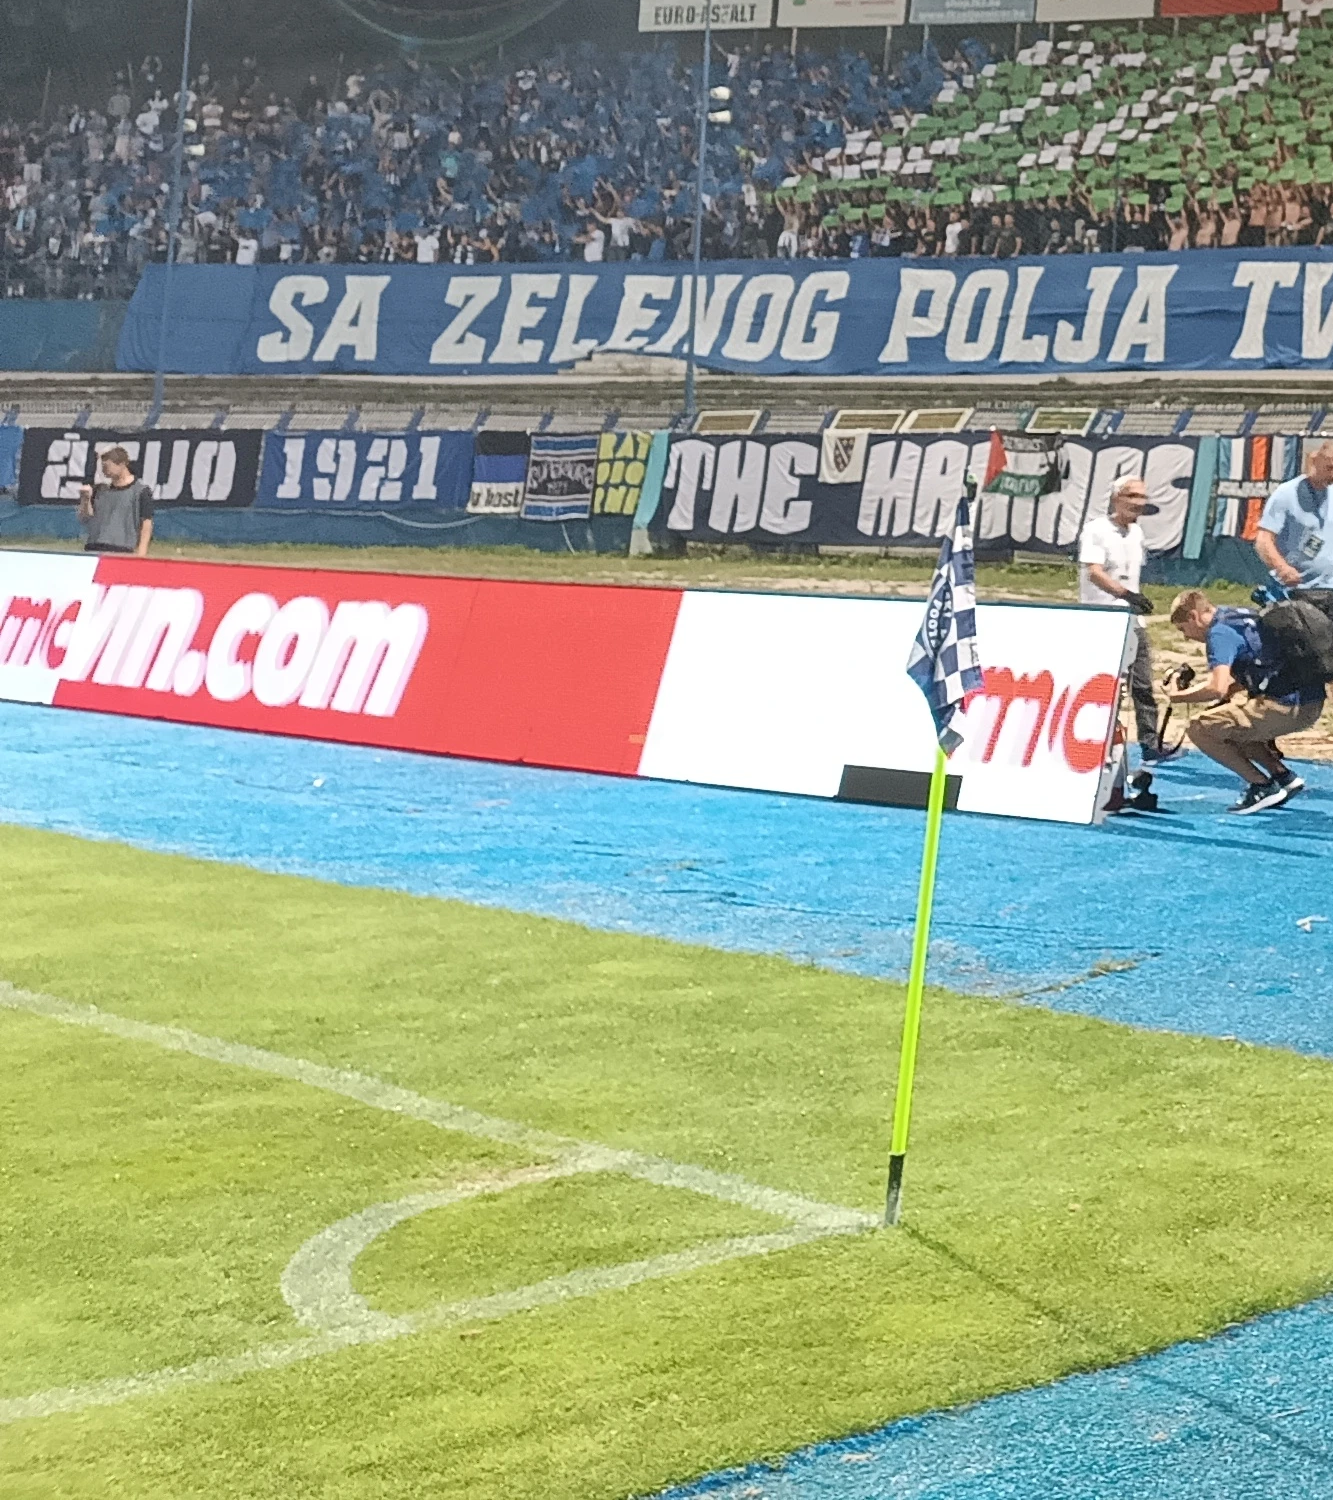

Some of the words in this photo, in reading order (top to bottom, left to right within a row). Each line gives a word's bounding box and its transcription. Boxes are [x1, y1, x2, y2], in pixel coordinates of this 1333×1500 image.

[257, 275, 391, 364] SA
[429, 270, 851, 365] ZELENOG
[879, 264, 1179, 363] POLJA
[276, 435, 442, 500] 1921
[664, 439, 818, 535] THE
